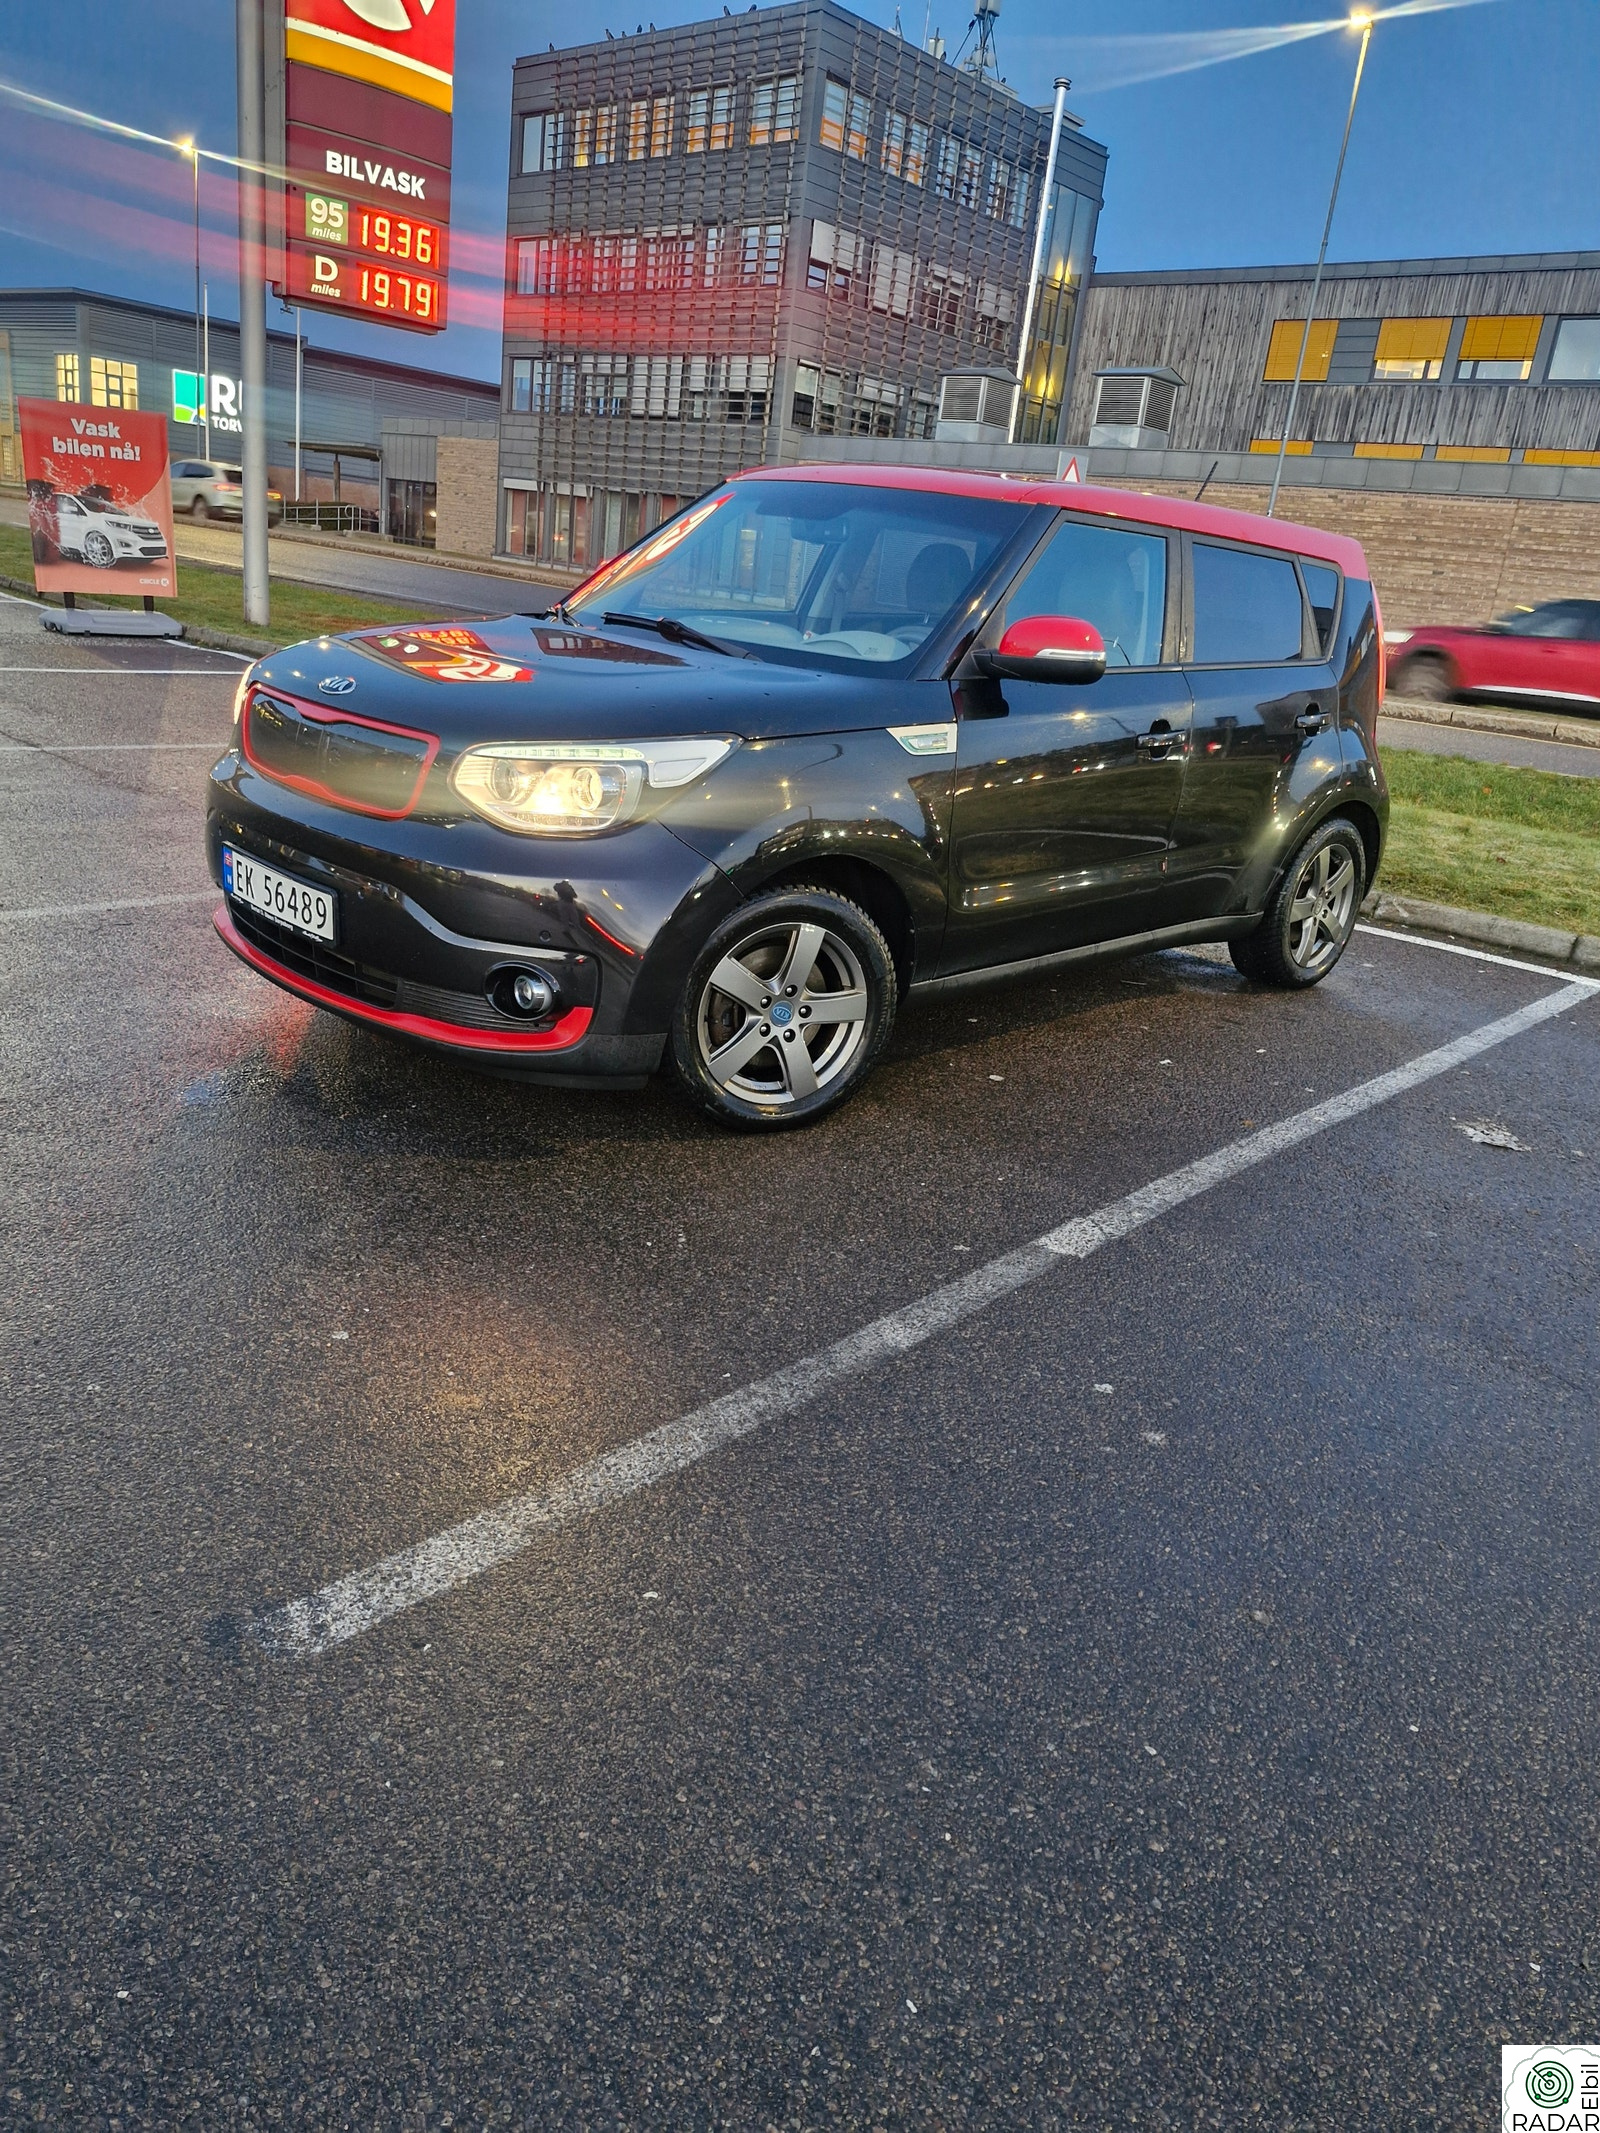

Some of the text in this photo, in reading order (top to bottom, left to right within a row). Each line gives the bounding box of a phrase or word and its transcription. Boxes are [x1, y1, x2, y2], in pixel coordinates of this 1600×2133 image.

[326, 150, 426, 200] BILVASK
[310, 197, 344, 229] 95
[311, 226, 342, 242] miles
[362, 213, 432, 264] 19.36
[315, 255, 339, 282] D
[311, 282, 341, 298] miles
[362, 270, 432, 317] 19.79
[211, 374, 242, 416] R
[70, 418, 121, 439] Vask
[52, 437, 141, 461] bilen nå!
[236, 860, 255, 899] EK
[264, 875, 327, 929] 56489
